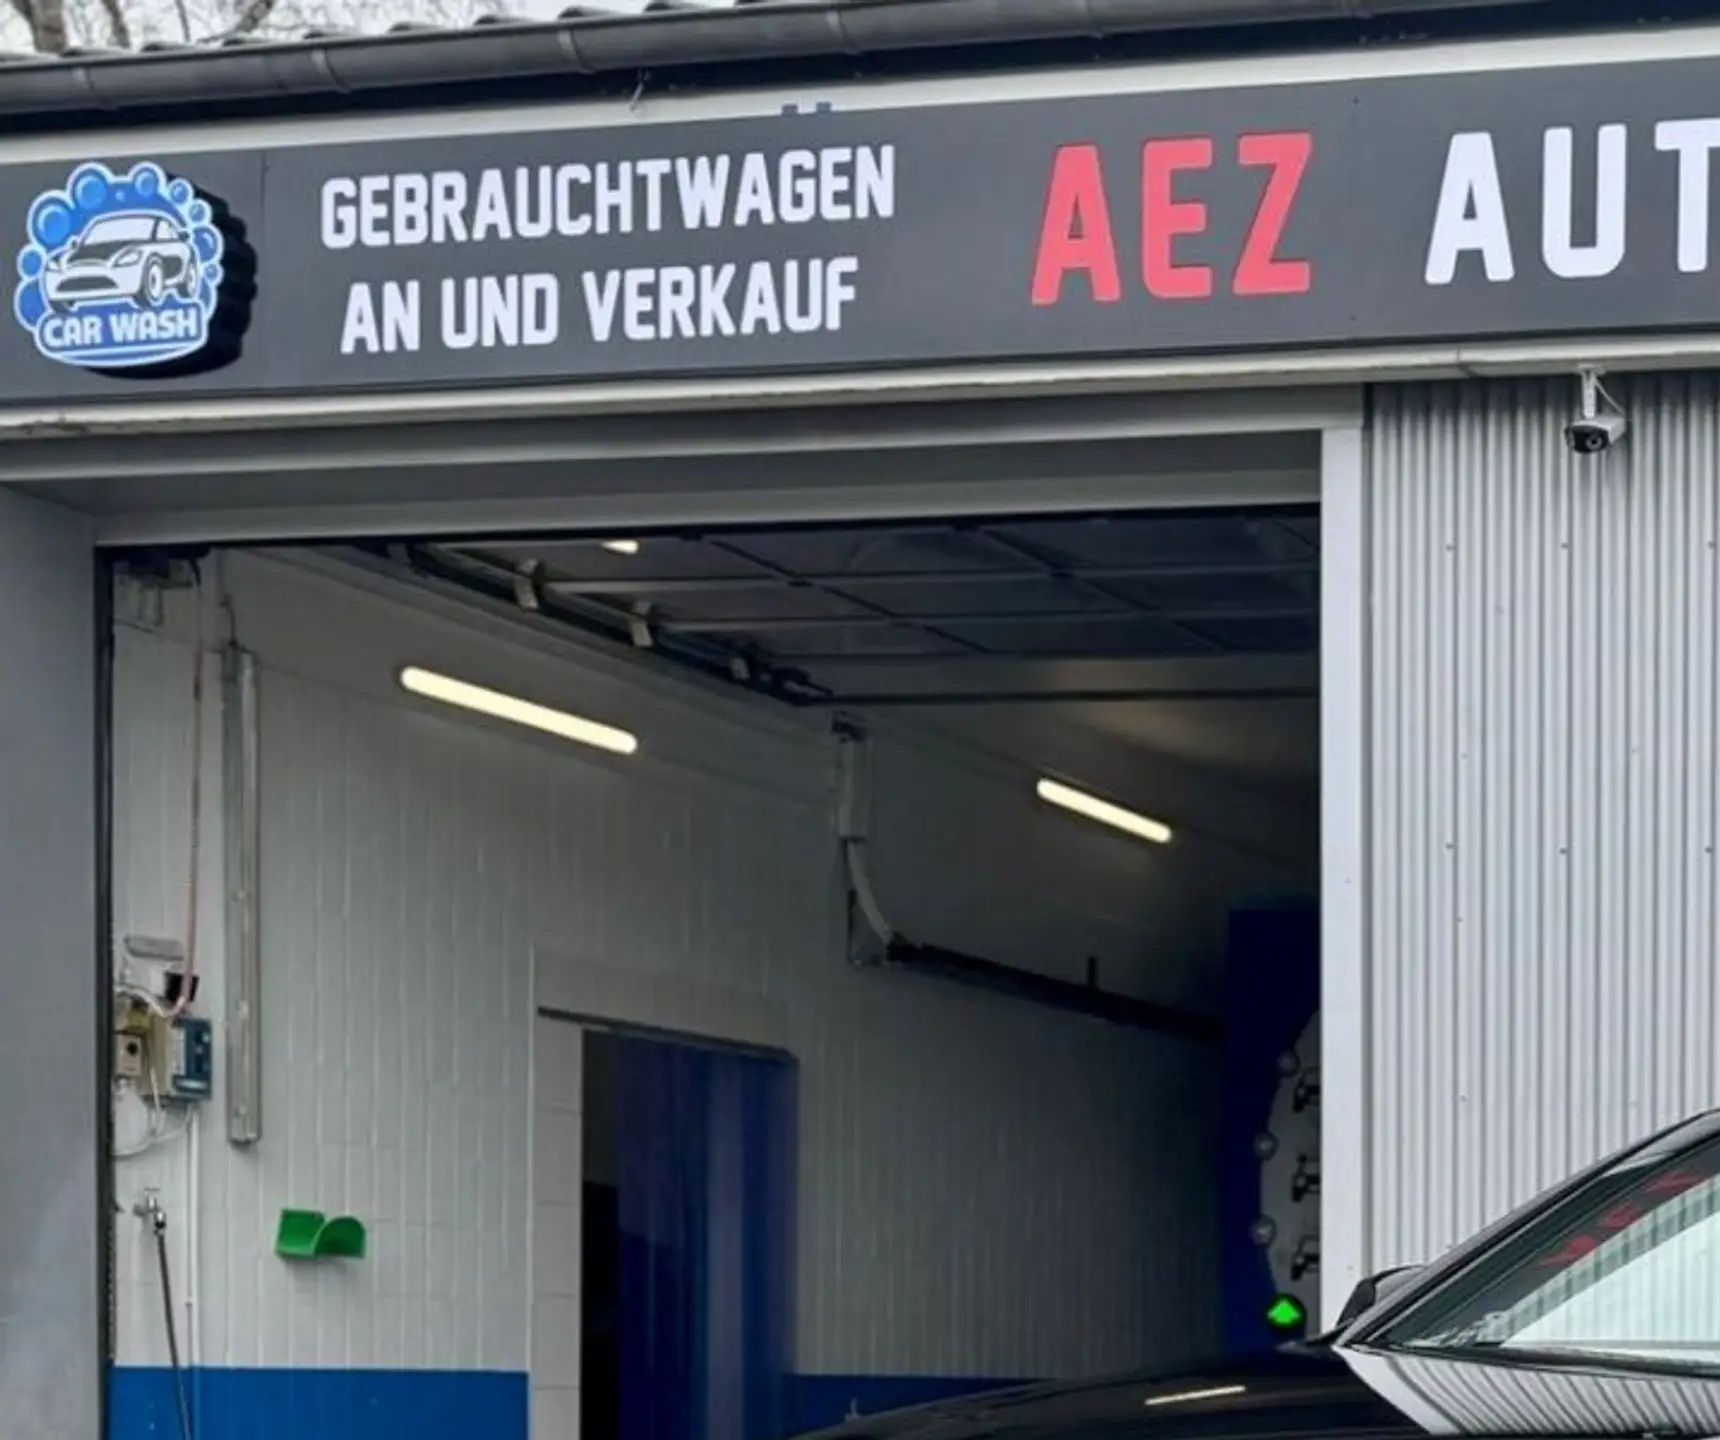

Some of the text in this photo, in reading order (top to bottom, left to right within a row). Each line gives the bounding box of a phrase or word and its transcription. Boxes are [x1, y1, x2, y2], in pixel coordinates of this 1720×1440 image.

[320, 144, 896, 249] GEBRAUCHTWAGEN
[1031, 131, 1313, 306] AEZ
[44, 307, 198, 347] CAR WASH
[340, 257, 859, 355] AN UND VERKAUF
